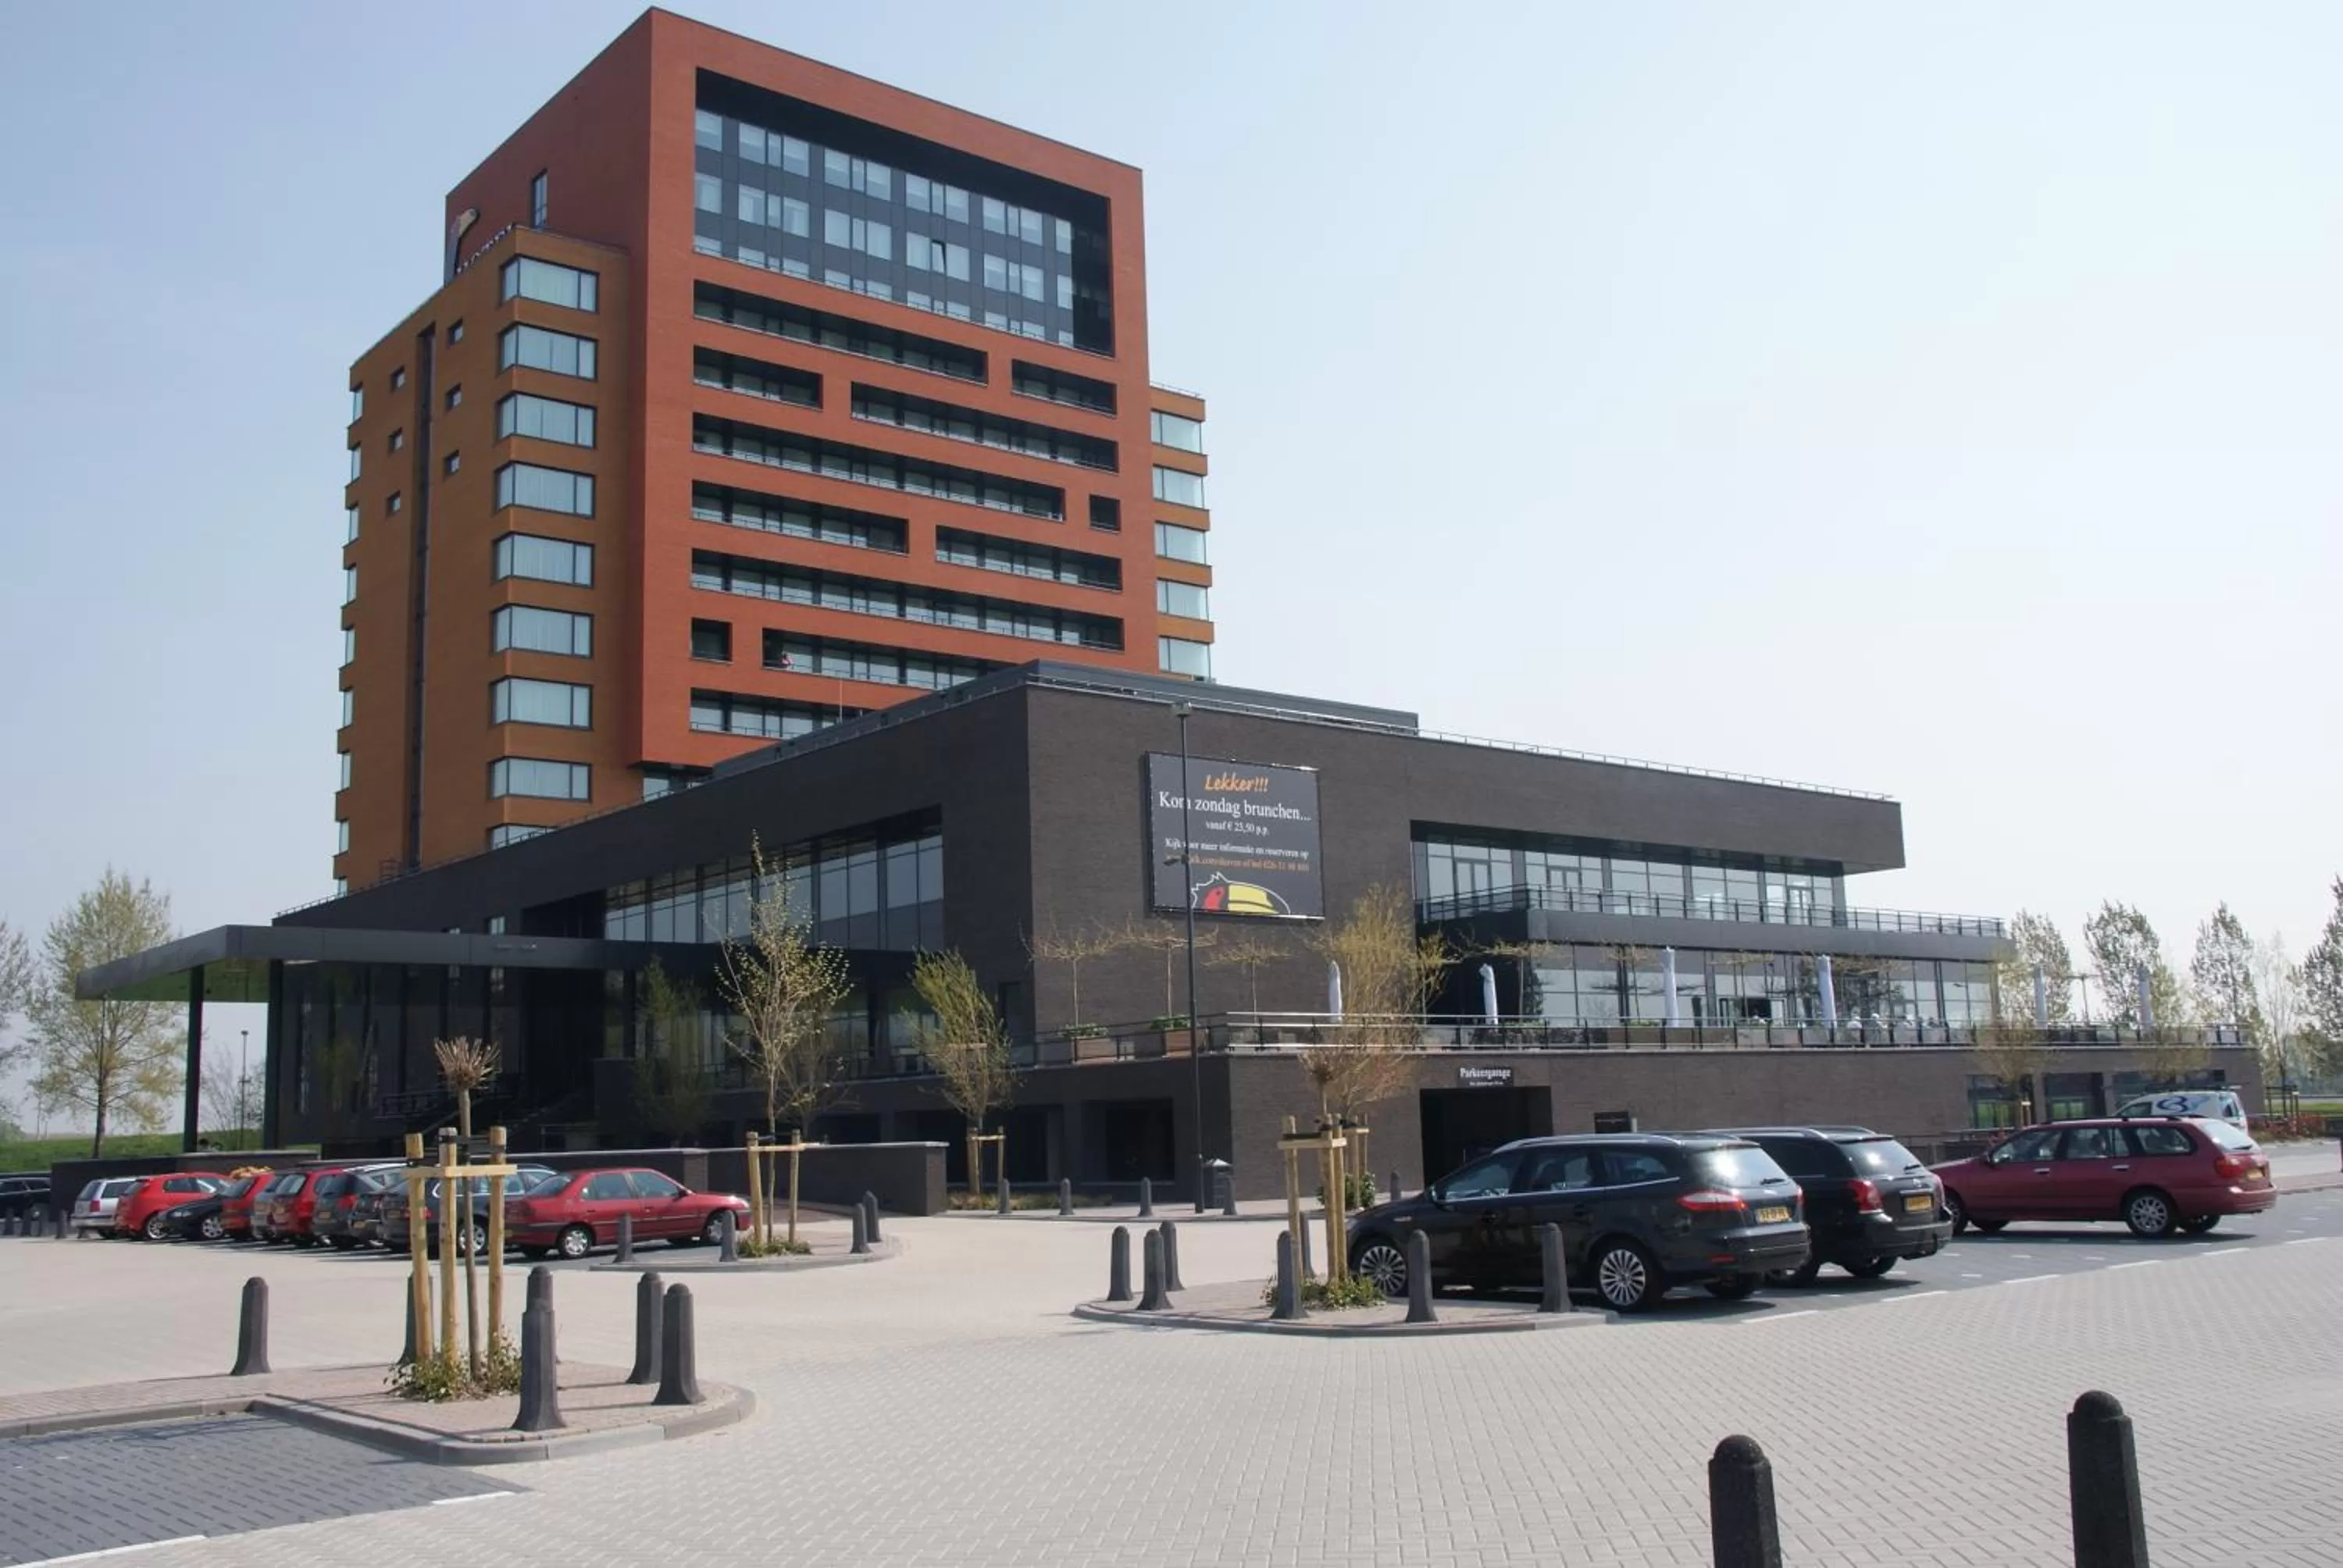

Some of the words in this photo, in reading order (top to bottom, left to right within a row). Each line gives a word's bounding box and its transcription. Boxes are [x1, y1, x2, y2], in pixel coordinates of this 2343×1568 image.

[1204, 772, 1269, 793] Lekker!!!
[1159, 791, 1191, 809] Kom
[1195, 797, 1241, 818] zondag
